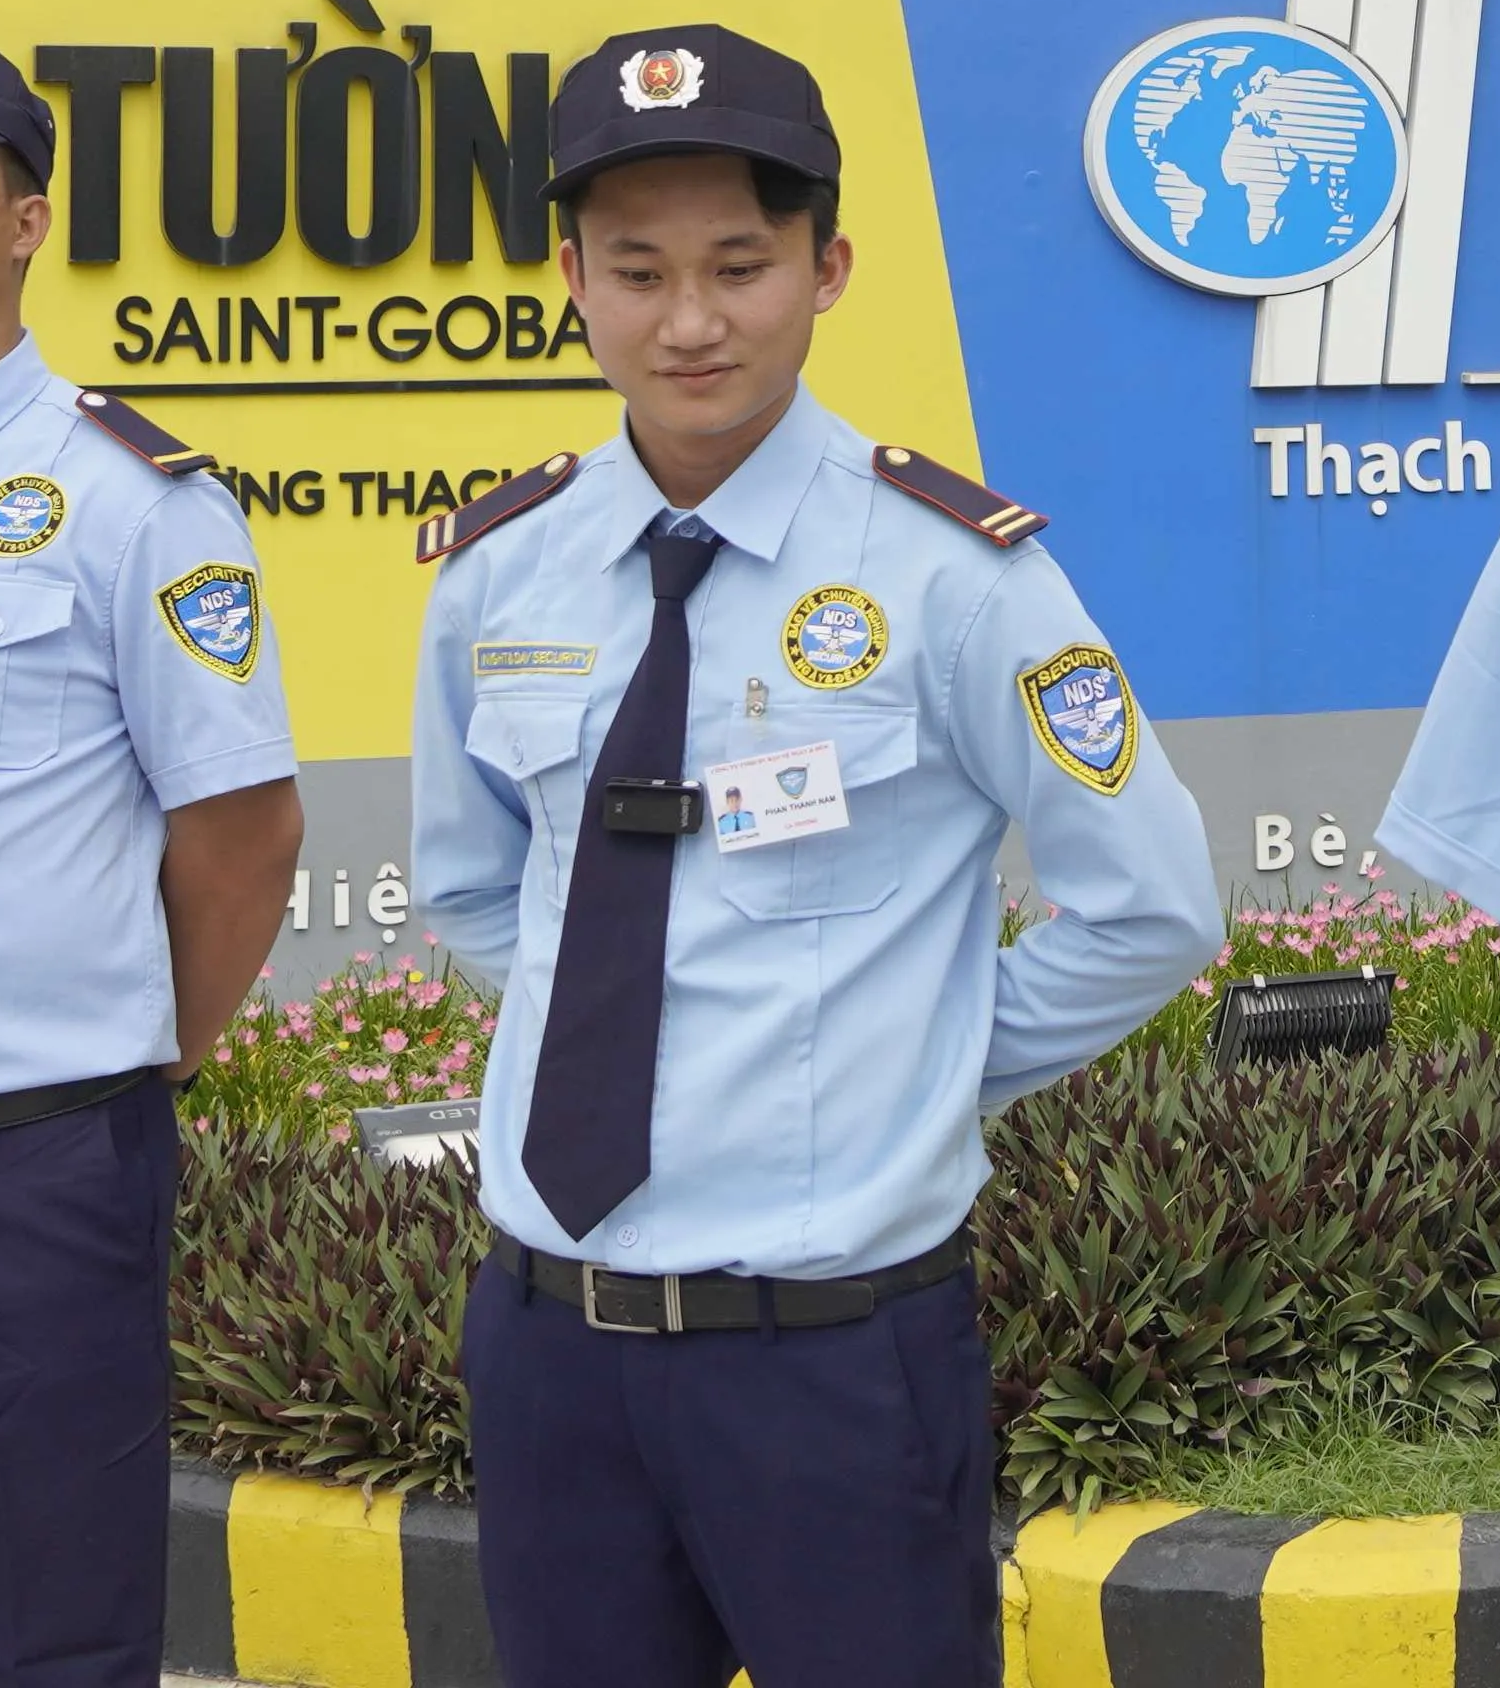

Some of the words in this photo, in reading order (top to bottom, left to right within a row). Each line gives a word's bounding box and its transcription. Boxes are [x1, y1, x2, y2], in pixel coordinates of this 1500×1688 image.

[113, 294, 593, 364] SAINT-GOBA
[1253, 420, 1493, 517] Thạch
[13, 494, 42, 509] NDS
[171, 566, 246, 600] SECURITY
[199, 588, 235, 613] NDS
[820, 608, 858, 629] NDS
[1037, 649, 1114, 688] SECURITY
[1063, 675, 1108, 709] NDS
[428, 1107, 478, 1121] LED
